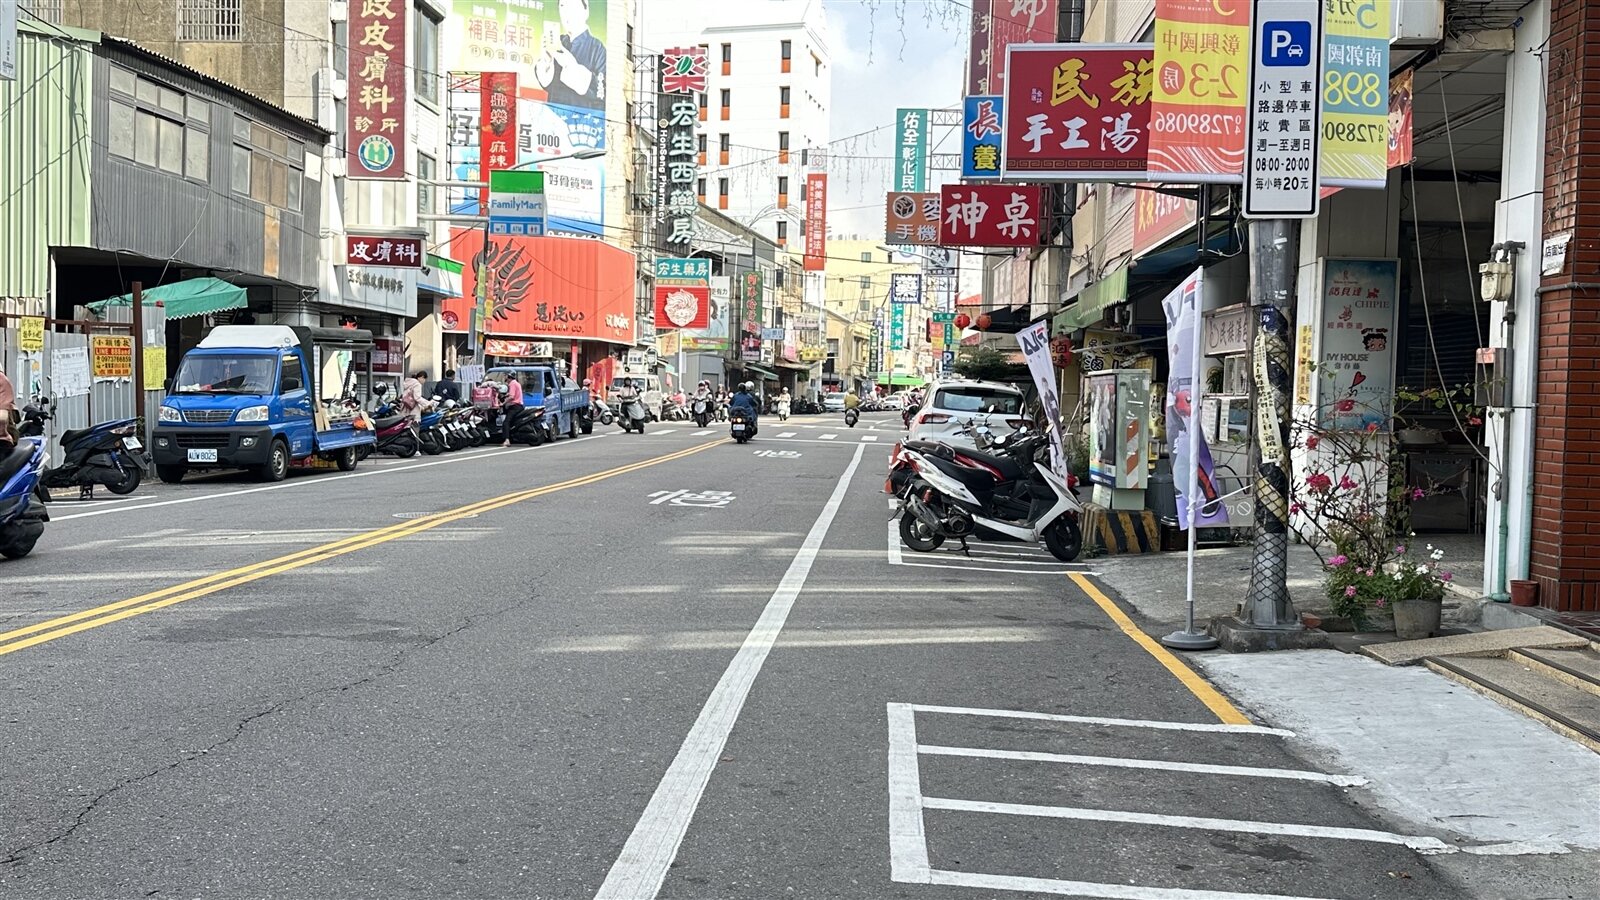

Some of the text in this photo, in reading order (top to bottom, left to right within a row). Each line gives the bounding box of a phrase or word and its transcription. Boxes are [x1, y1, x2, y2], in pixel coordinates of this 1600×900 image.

[1270, 30, 1292, 58] P
[1259, 80, 1312, 94] 小型車
[1258, 100, 1311, 113] 路邊停車
[354, 116, 399, 133] 診所
[1021, 111, 1151, 154] 手工湯
[1257, 119, 1311, 132] 收費區
[489, 140, 508, 167] 麻辣
[902, 112, 921, 192] 佑全彰化民
[1257, 138, 1310, 152] 週一至週日
[667, 99, 698, 245] 宏生西藥房
[491, 196, 543, 211] FamilyMart
[944, 191, 1036, 240] 神桌
[895, 223, 937, 242] 手機
[349, 240, 419, 263] 皮膚科
[657, 262, 708, 276] 宏生藥房
[1354, 300, 1390, 309] CHIPIE
[1326, 353, 1369, 362] IVY HOUSE
